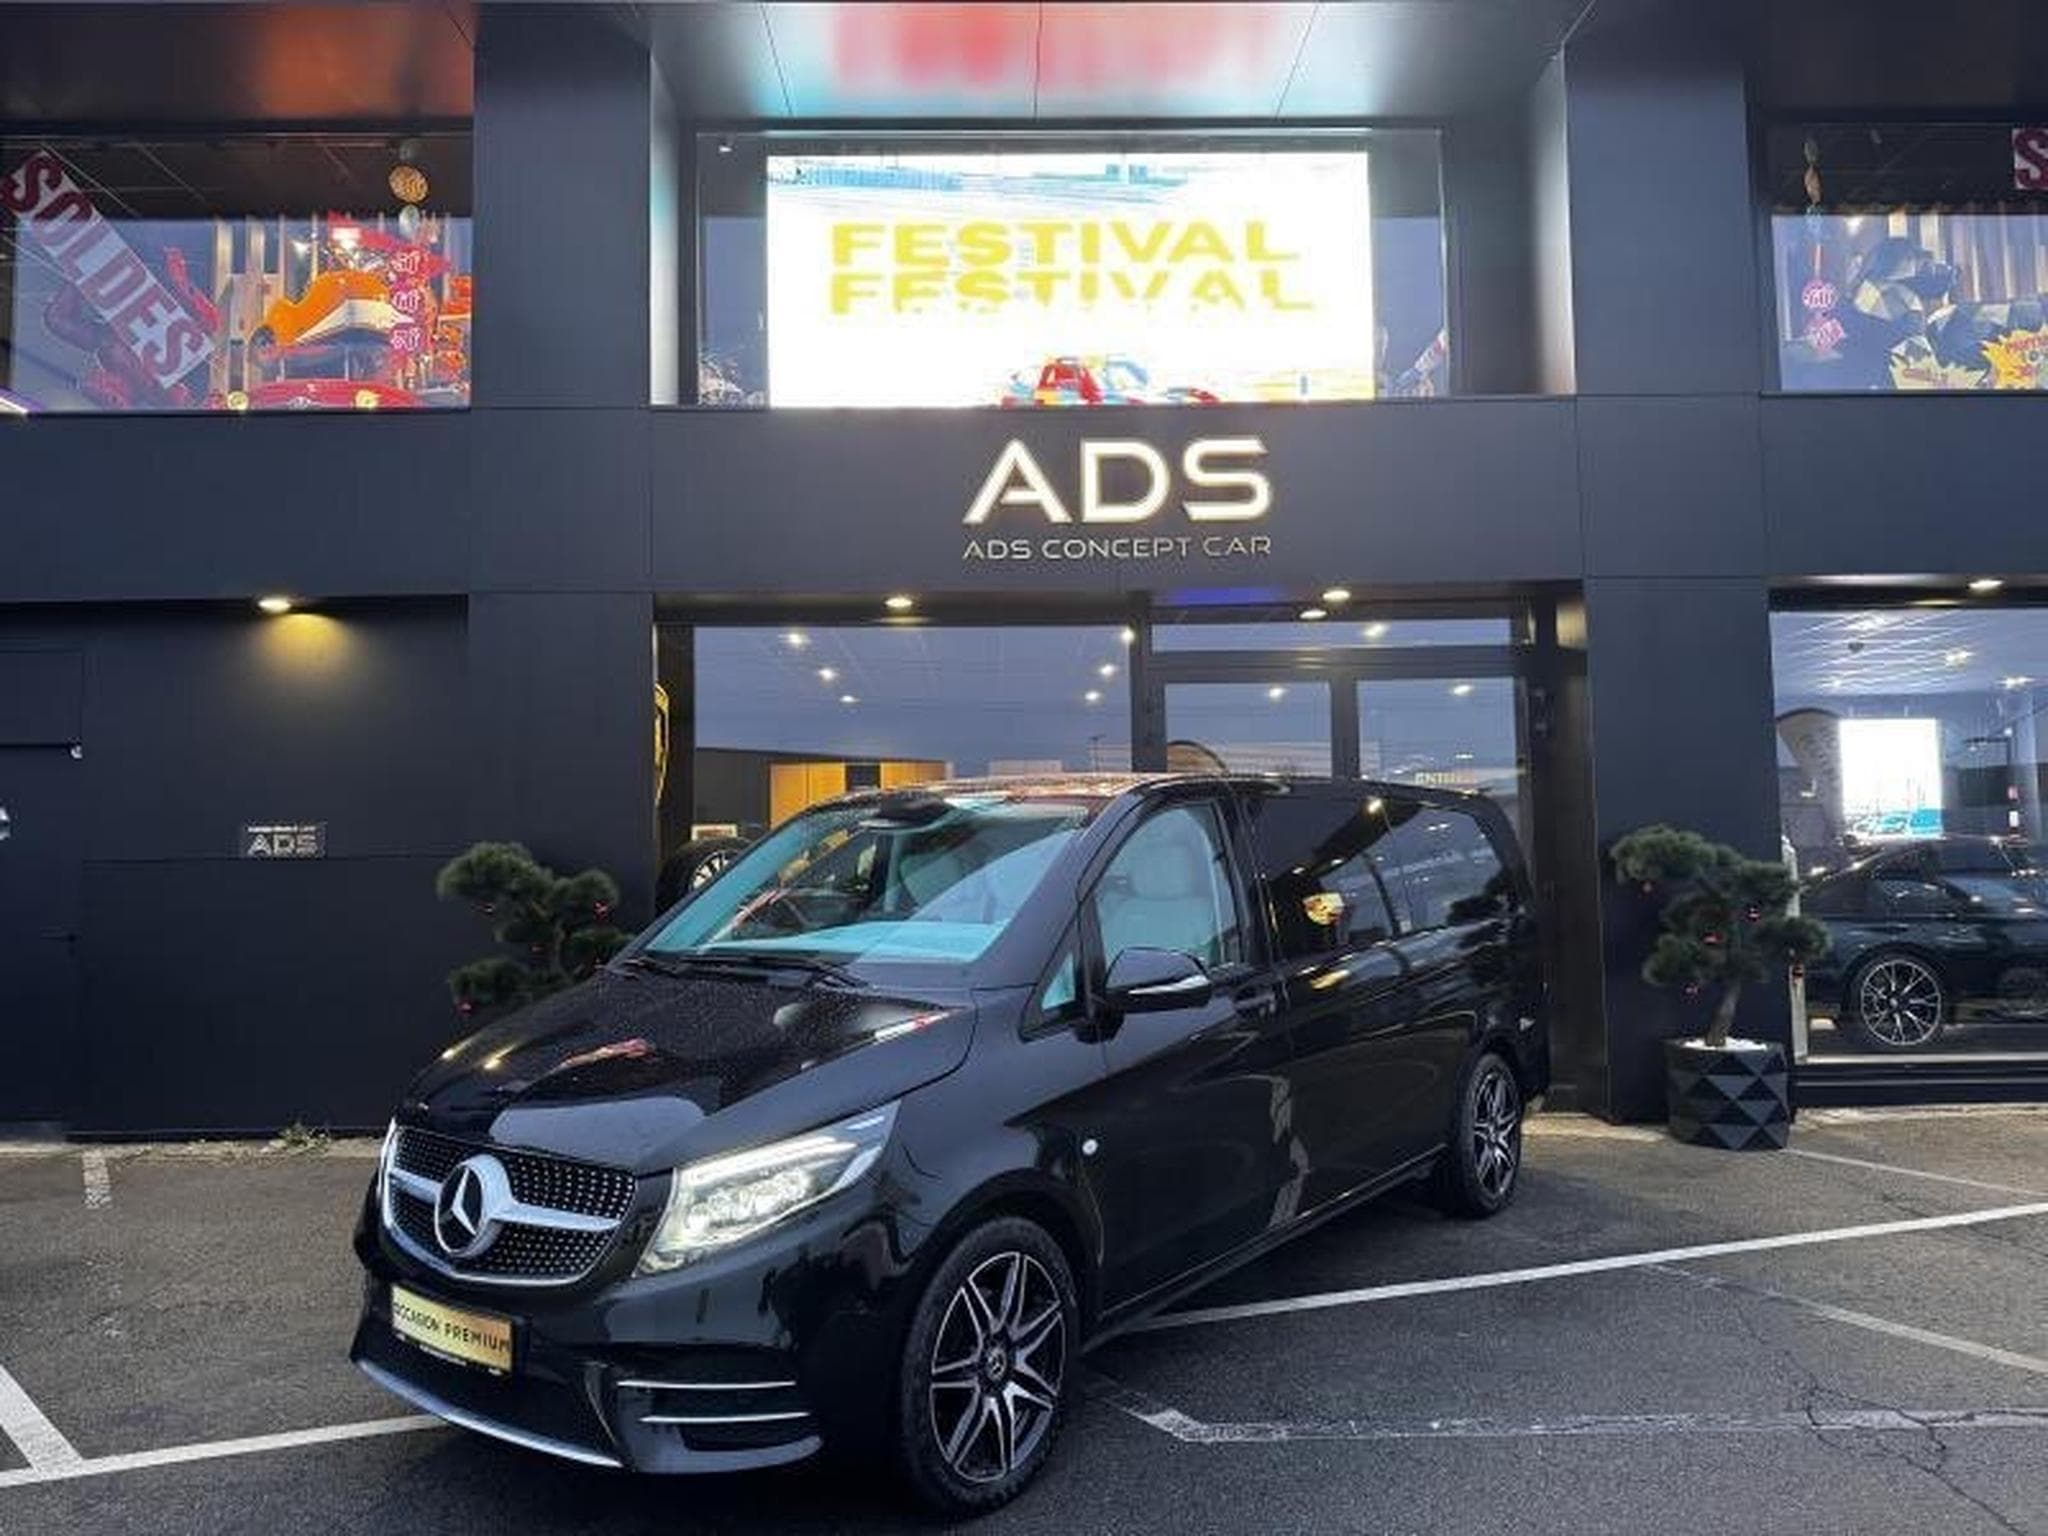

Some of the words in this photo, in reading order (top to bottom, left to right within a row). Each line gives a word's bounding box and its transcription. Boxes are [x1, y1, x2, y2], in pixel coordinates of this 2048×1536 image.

[829, 219, 1301, 267] FESTIVAL
[0, 151, 206, 384] SOLDES
[962, 437, 1273, 525] ADS
[962, 539, 1031, 560] ADS
[1041, 536, 1192, 559] CONCEPT
[1203, 535, 1272, 557] CAR
[247, 833, 318, 858] ADS
